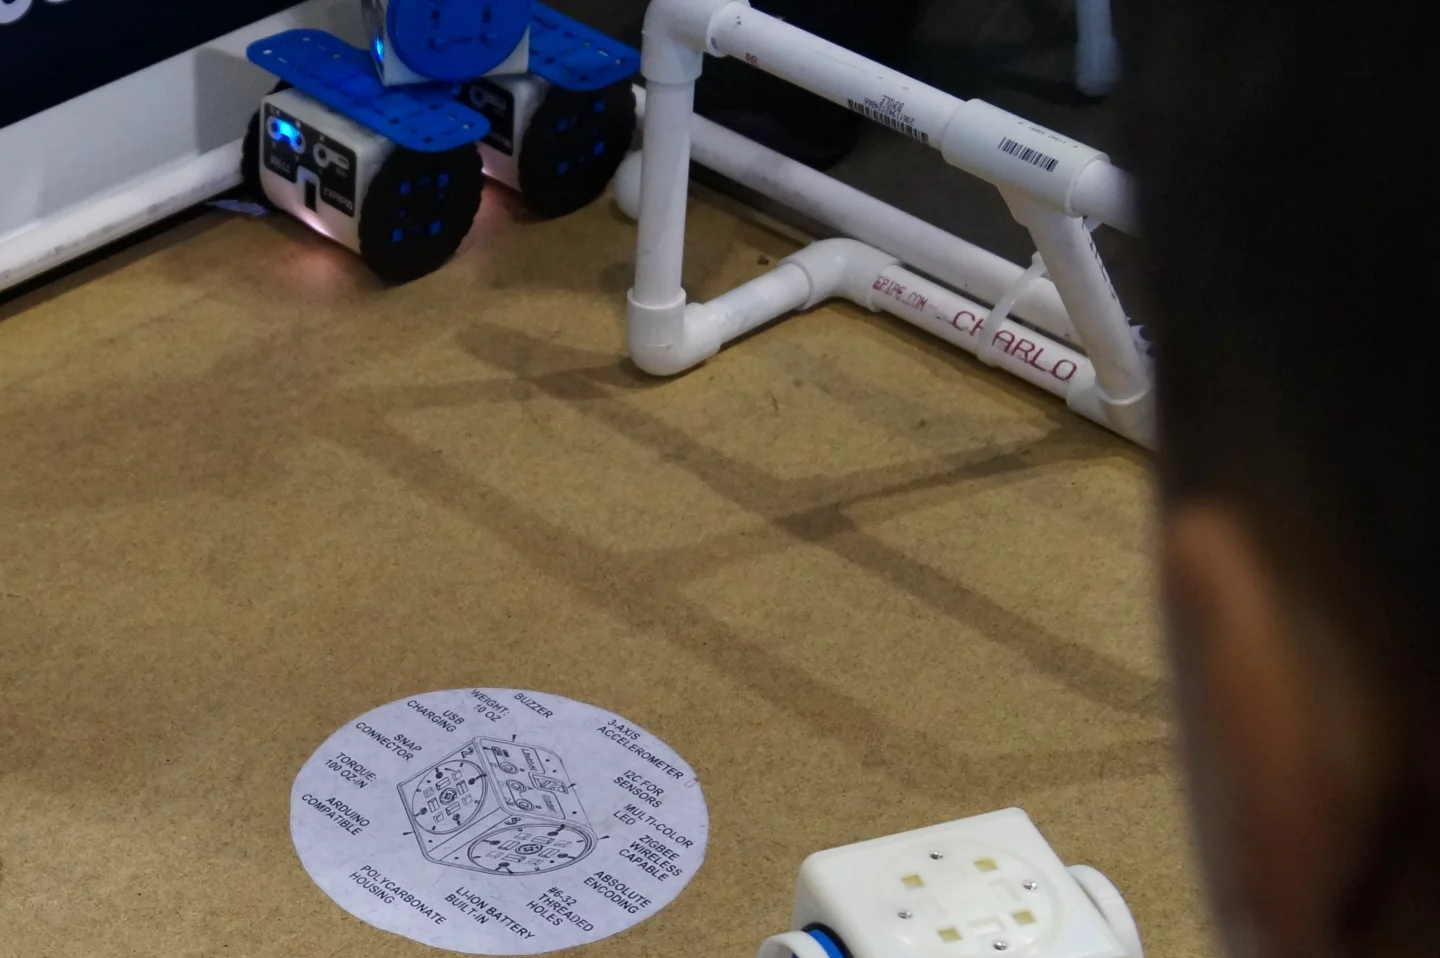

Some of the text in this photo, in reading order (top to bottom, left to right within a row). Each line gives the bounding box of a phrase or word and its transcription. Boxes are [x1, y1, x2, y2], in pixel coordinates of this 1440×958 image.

[407, 700, 456, 733] CHARGING
[442, 709, 465, 725] USB
[470, 689, 510, 715] WEIGHT:
[475, 704, 503, 722] 10 OZ
[513, 692, 553, 718] BUZZER
[355, 721, 414, 762] CONNECTOR
[394, 733, 422, 752] SNAP
[607, 719, 641, 741] 3-AXIS
[335, 752, 377, 781] TORQUE:
[597, 726, 684, 780] ACCELEROMETER
[324, 759, 368, 789] 100 OZ-IN
[640, 779, 664, 797] FOR
[613, 776, 662, 808] SENSORS
[301, 793, 363, 836] COMPATIBLE
[325, 797, 370, 827] ARDUINO
[613, 810, 636, 826] LED
[623, 803, 694, 849] MULTI-COLOR
[629, 841, 683, 877] WIRELESS
[638, 834, 680, 861] ZIGBEE
[619, 849, 670, 882] CAPABLE
[349, 872, 395, 904] HOUSING
[360, 865, 447, 925] POLYCARBONATE
[548, 887, 577, 907] #6-32
[583, 877, 640, 914] ENCODING
[593, 870, 652, 909] ABSOLUTE
[444, 893, 489, 925] BUILT-IN
[456, 886, 536, 940] LI-ION BATTERY
[526, 900, 564, 927] HOLES
[538, 893, 594, 932] THREADED
